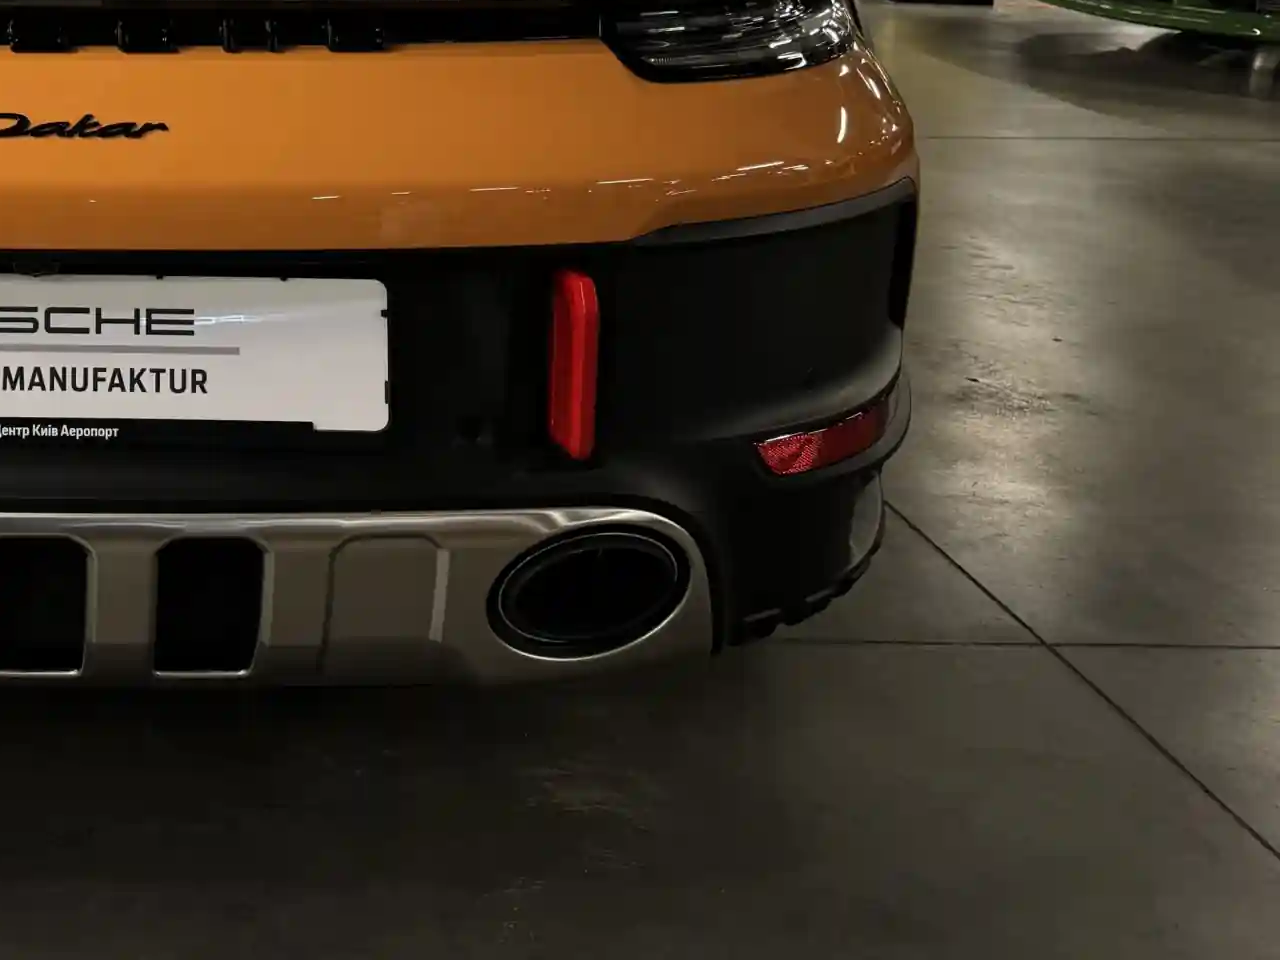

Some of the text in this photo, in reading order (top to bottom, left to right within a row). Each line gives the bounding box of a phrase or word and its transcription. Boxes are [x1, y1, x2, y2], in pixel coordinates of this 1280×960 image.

[1, 366, 209, 394] MANUFAKTUR
[32, 424, 58, 437] Київ
[60, 425, 119, 440] Аеропорт
